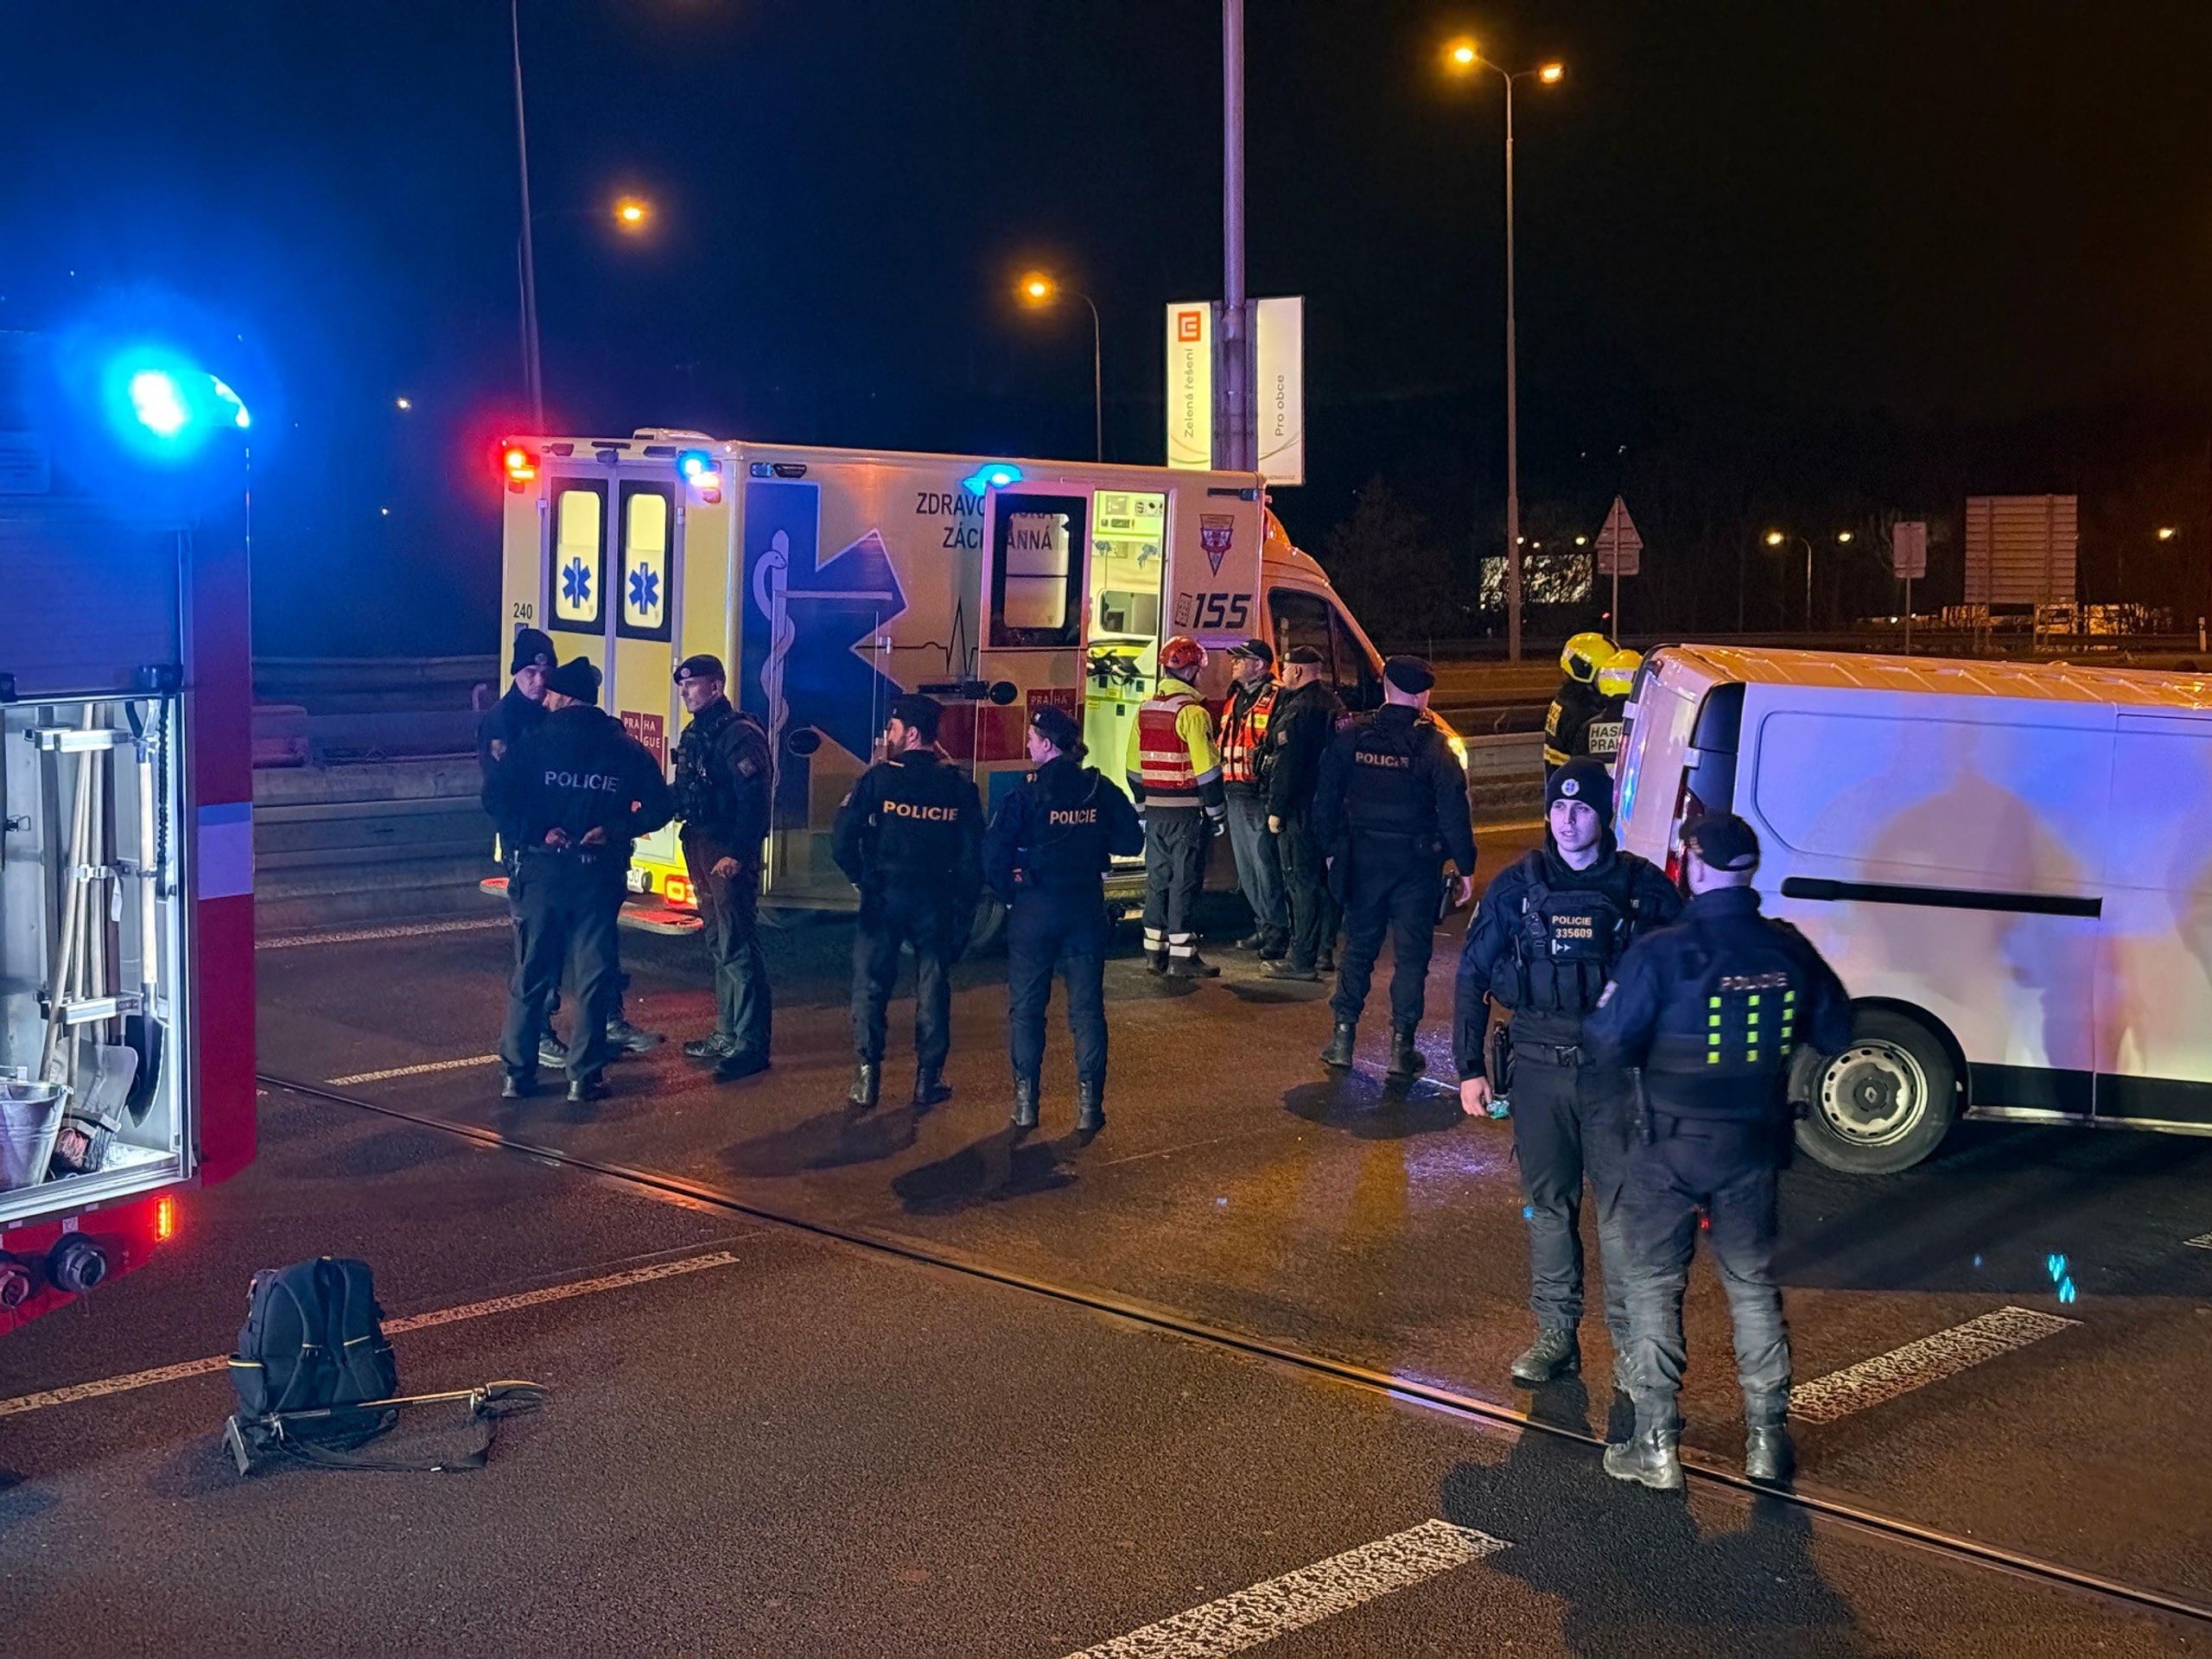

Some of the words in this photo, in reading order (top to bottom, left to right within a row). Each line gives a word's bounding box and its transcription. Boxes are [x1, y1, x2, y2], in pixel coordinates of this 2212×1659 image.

[1184, 348, 1194, 390] řešení
[1275, 374, 1285, 410] obce
[1274, 413, 1285, 436] Pro
[512, 601, 533, 620] 240
[1192, 593, 1252, 629] 155
[1591, 725, 1624, 738] HASI
[544, 771, 619, 793] POLICIE
[882, 799, 959, 822] POLICIE
[1049, 808, 1097, 825] POLICIE
[1551, 914, 1592, 926] POLICIE
[1554, 927, 1593, 939] 335609
